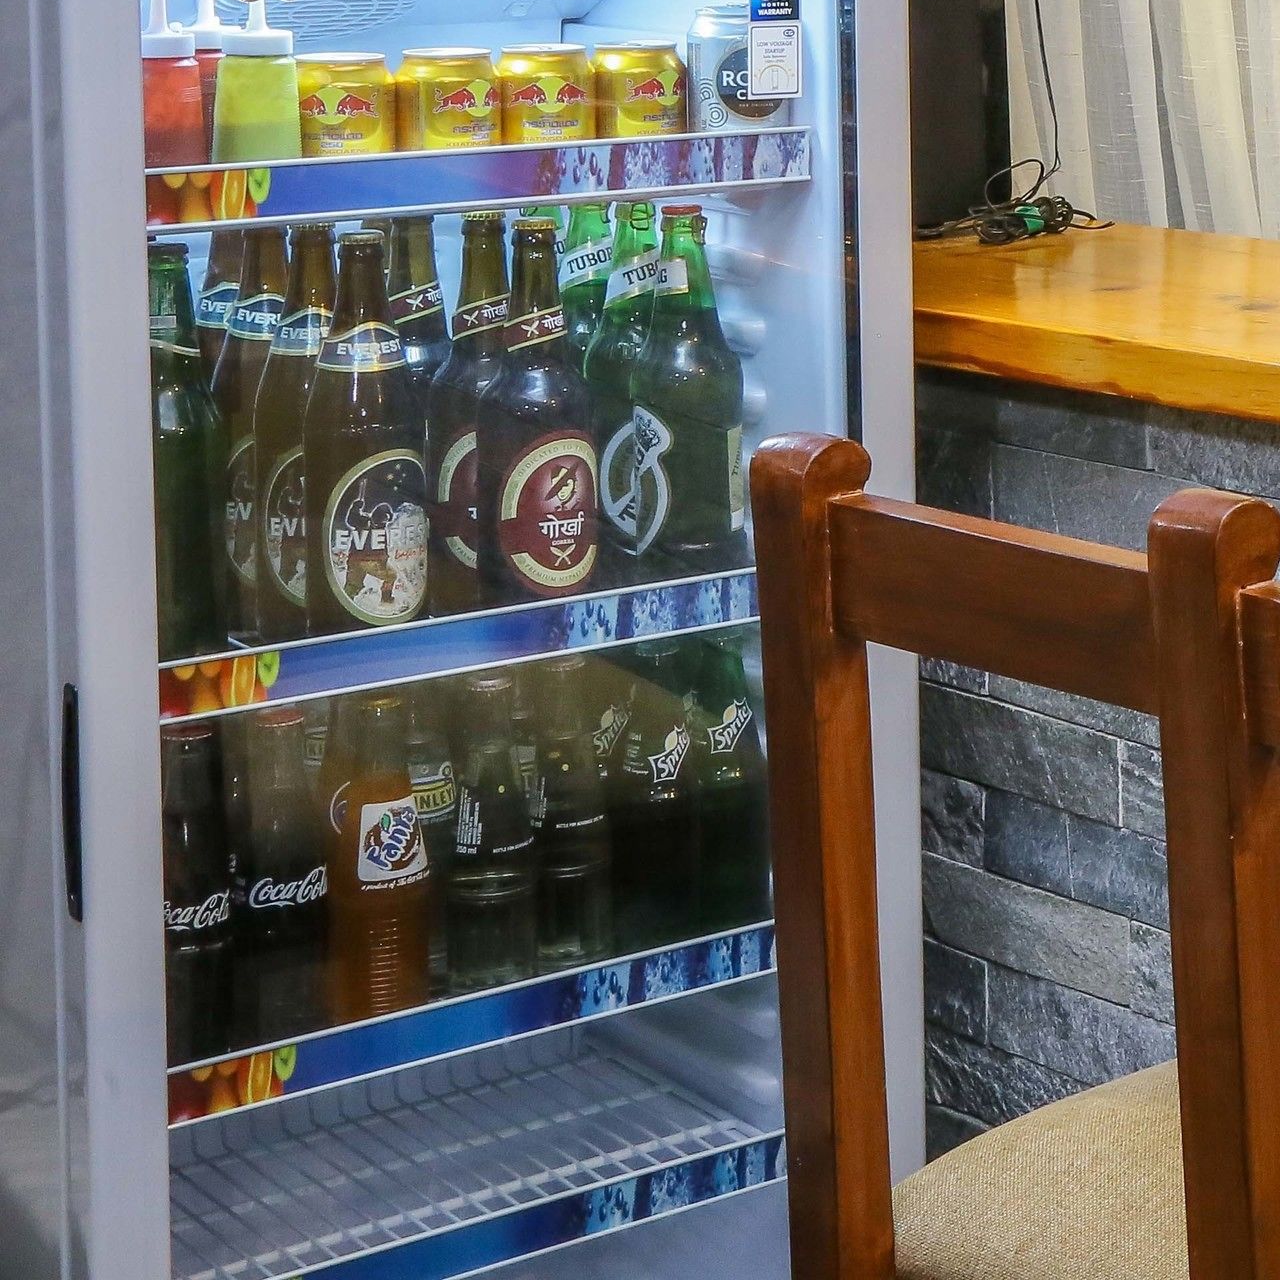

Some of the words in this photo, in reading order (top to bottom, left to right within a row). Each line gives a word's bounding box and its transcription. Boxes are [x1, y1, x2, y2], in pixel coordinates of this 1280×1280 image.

[758, 8, 792, 16] WARRANTY
[623, 259, 659, 285] TUB
[237, 308, 281, 327] EVER
[281, 326, 331, 340] EVERE
[538, 511, 585, 538] गोर्खा
[335, 523, 428, 551] EVERES
[415, 786, 454, 810] INLEY
